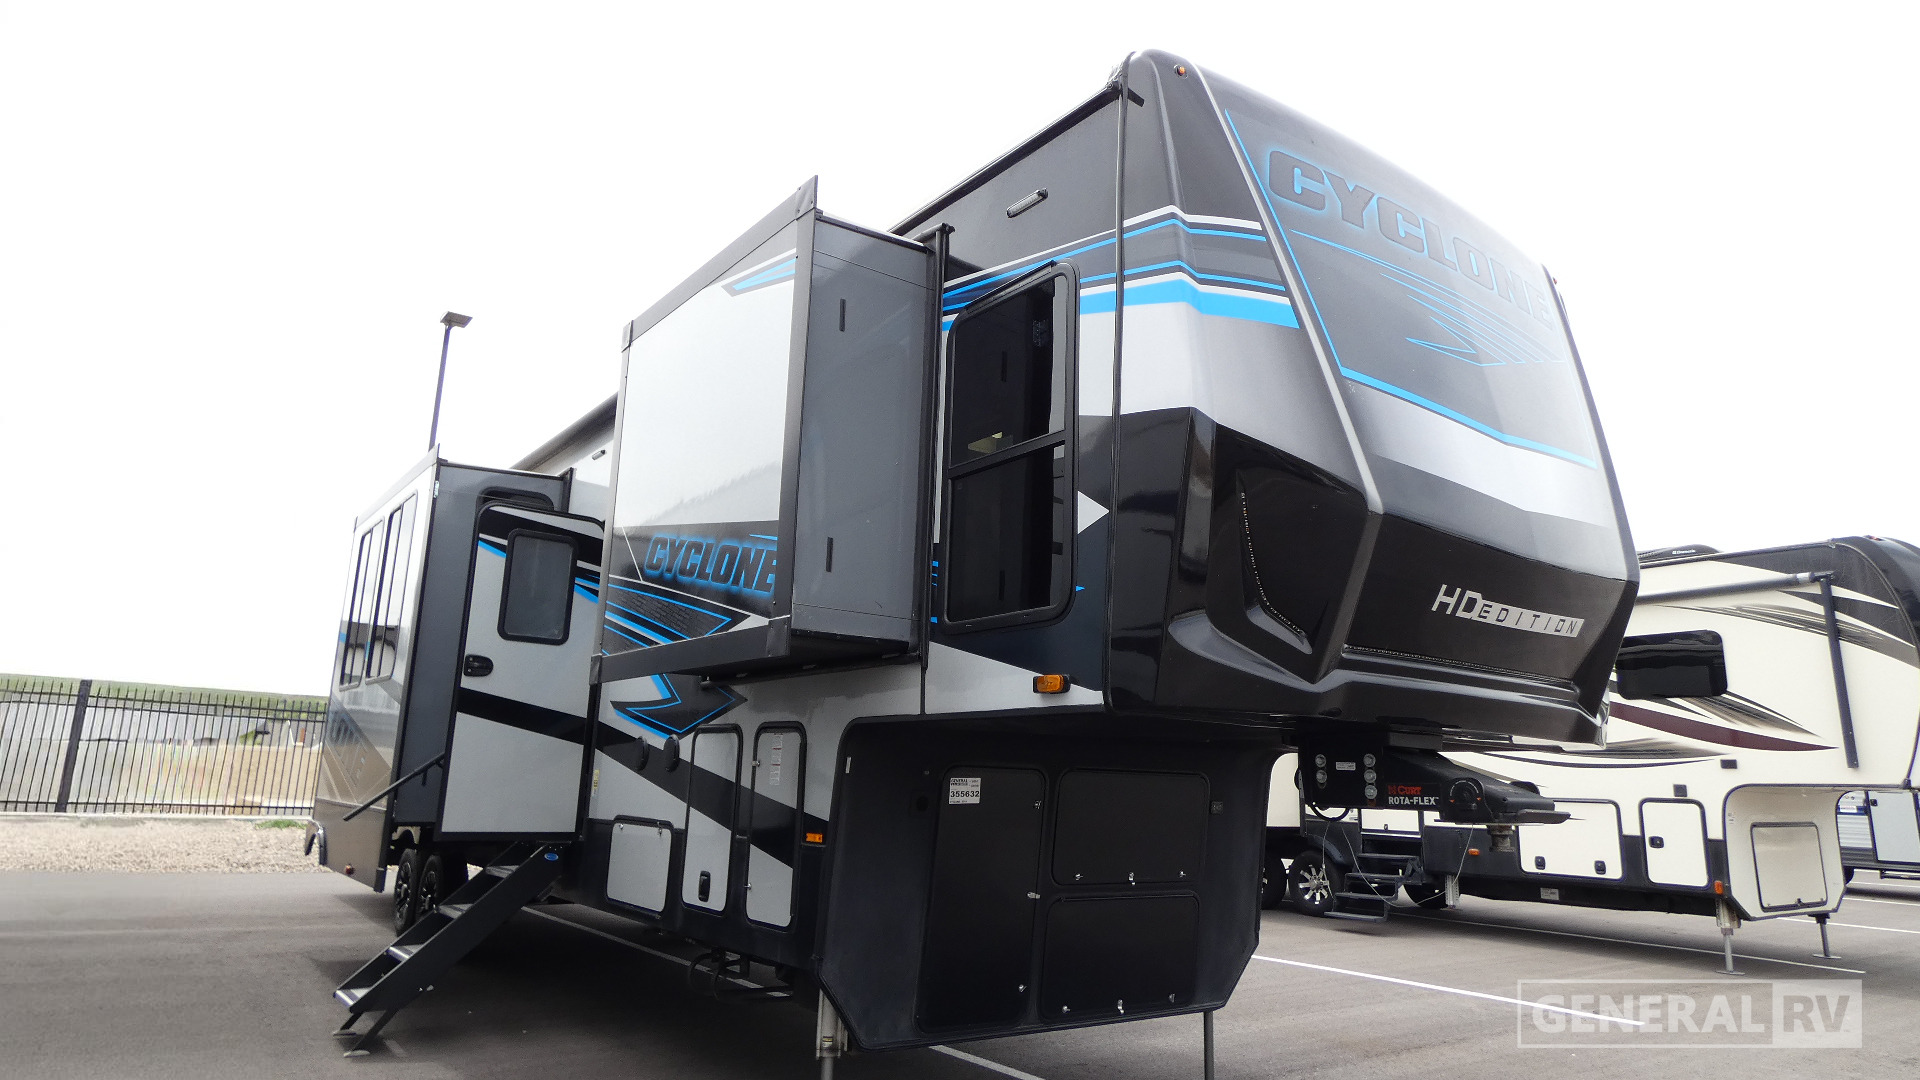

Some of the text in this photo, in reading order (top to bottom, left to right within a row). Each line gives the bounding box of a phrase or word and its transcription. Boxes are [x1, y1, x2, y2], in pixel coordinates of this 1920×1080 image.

[1268, 150, 1553, 326] CYCLONE
[644, 534, 778, 595] CYCLONE
[1431, 584, 1581, 636] HD EDITION
[950, 790, 980, 798] 355632
[1388, 796, 1437, 806] ROTA-FLEX
